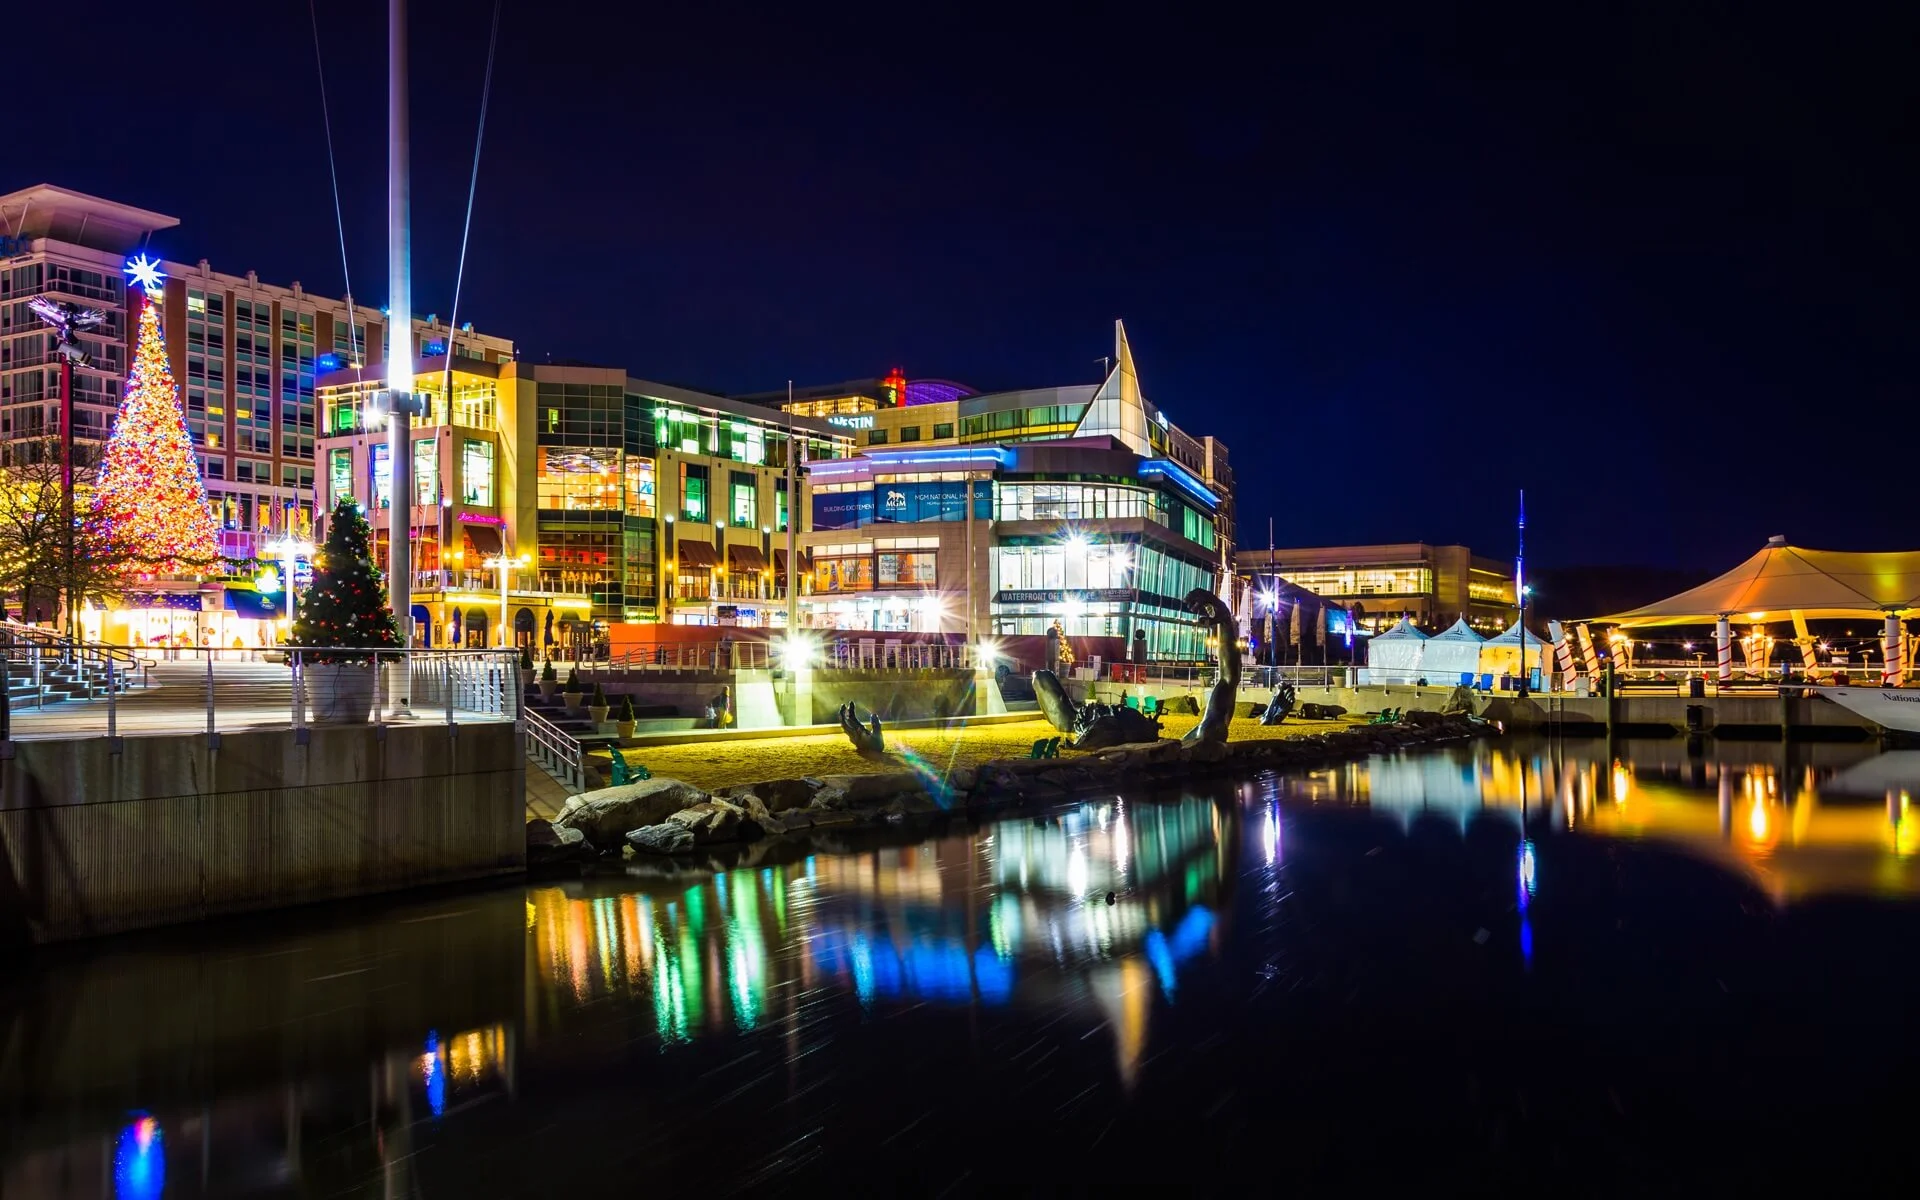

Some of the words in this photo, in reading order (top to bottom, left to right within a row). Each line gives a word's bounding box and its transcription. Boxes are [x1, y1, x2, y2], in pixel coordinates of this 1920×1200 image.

[886, 499, 906, 507] MGM
[823, 505, 845, 513] BUILDING
[846, 503, 874, 512] EXCITEMENT
[1001, 592, 1046, 601] WATERFRONT
[1048, 592, 1071, 601] OFFI
[1882, 692, 1920, 702] Nationa
